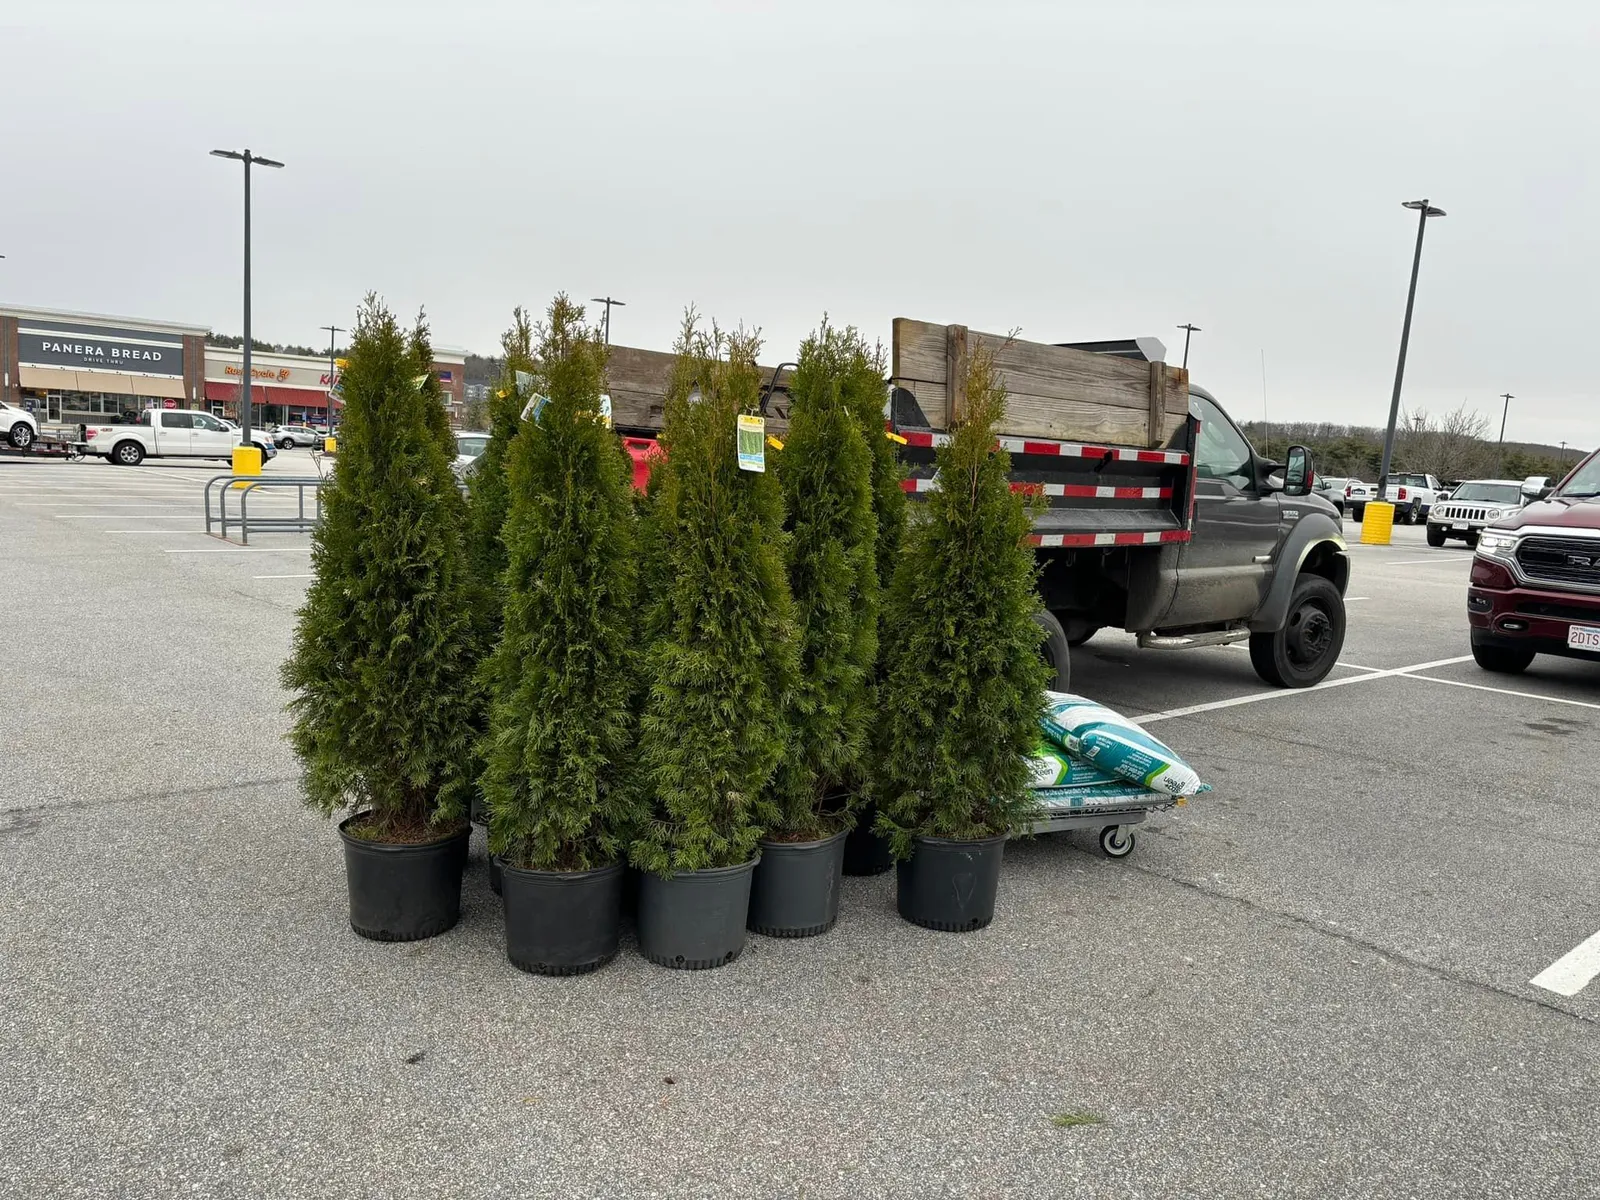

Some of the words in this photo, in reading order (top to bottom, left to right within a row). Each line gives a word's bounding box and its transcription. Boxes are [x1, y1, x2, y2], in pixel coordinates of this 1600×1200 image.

[42, 342, 104, 356] PANERA
[111, 348, 162, 361] BREAD
[1163, 776, 1186, 790] green
